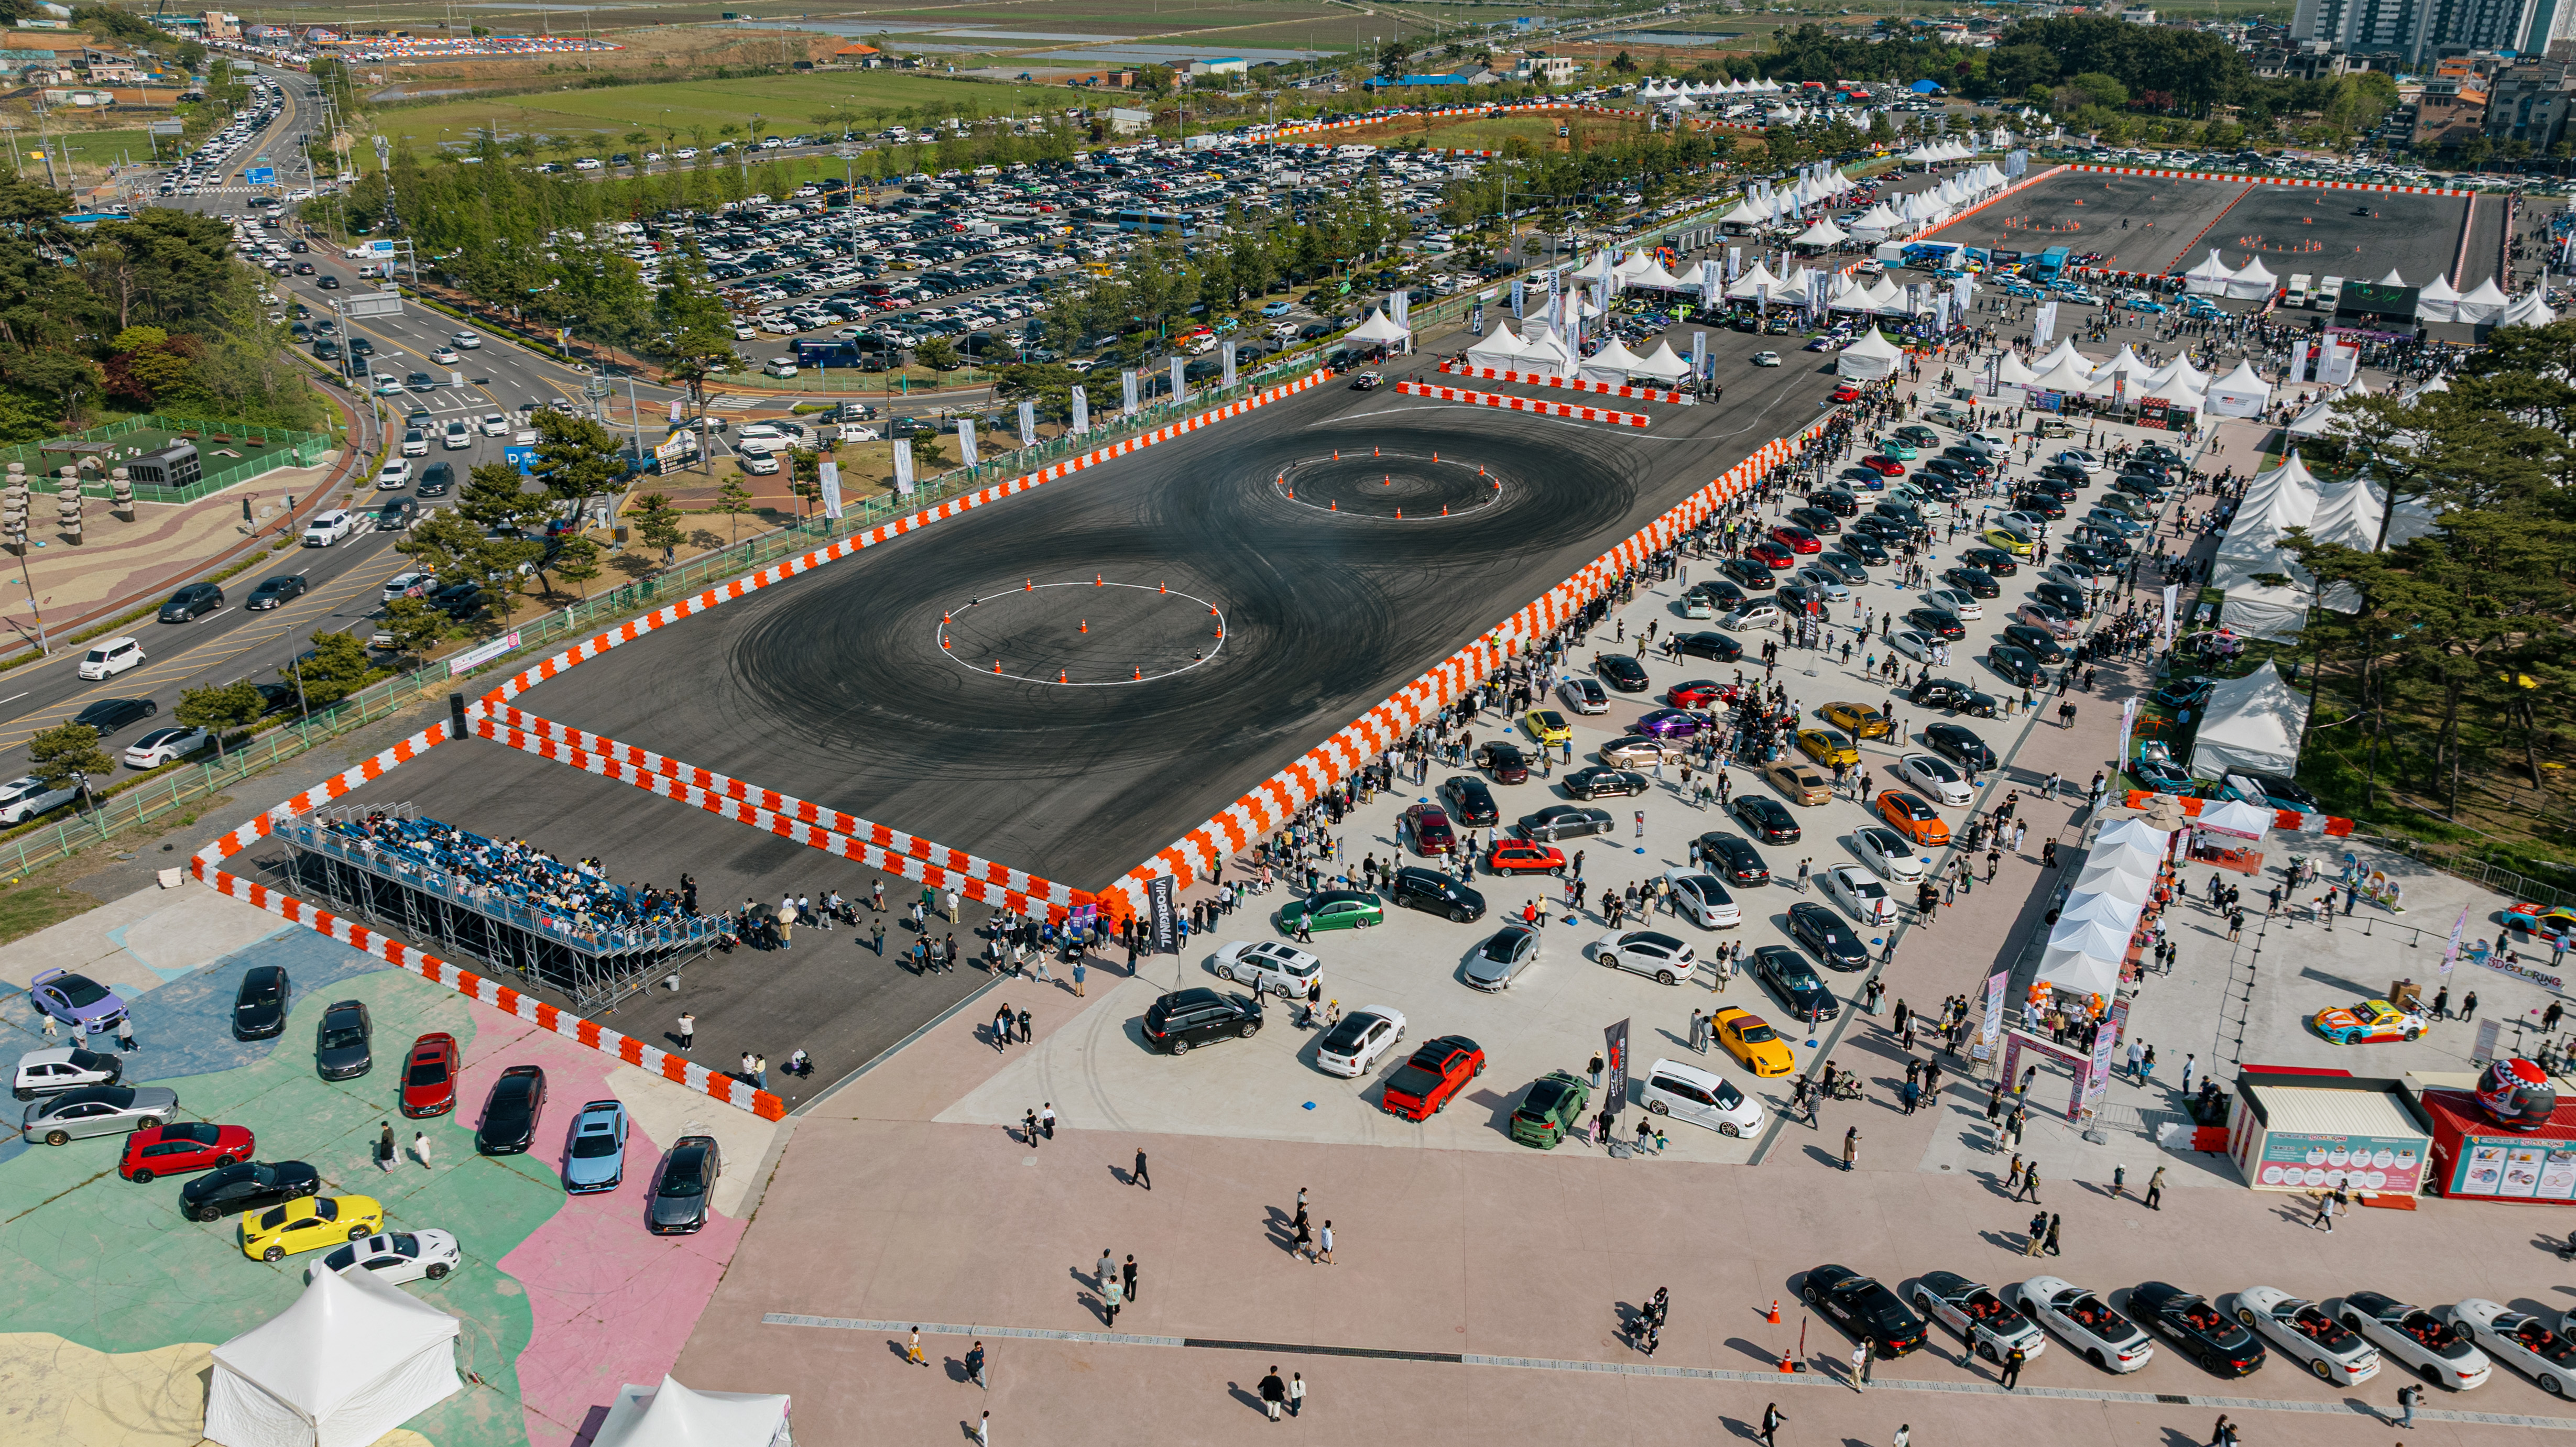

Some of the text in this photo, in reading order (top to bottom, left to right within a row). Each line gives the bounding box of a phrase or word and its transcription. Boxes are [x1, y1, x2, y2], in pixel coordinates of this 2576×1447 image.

[508, 454, 519, 463] P
[2488, 957, 2561, 986] 3D COLORING
